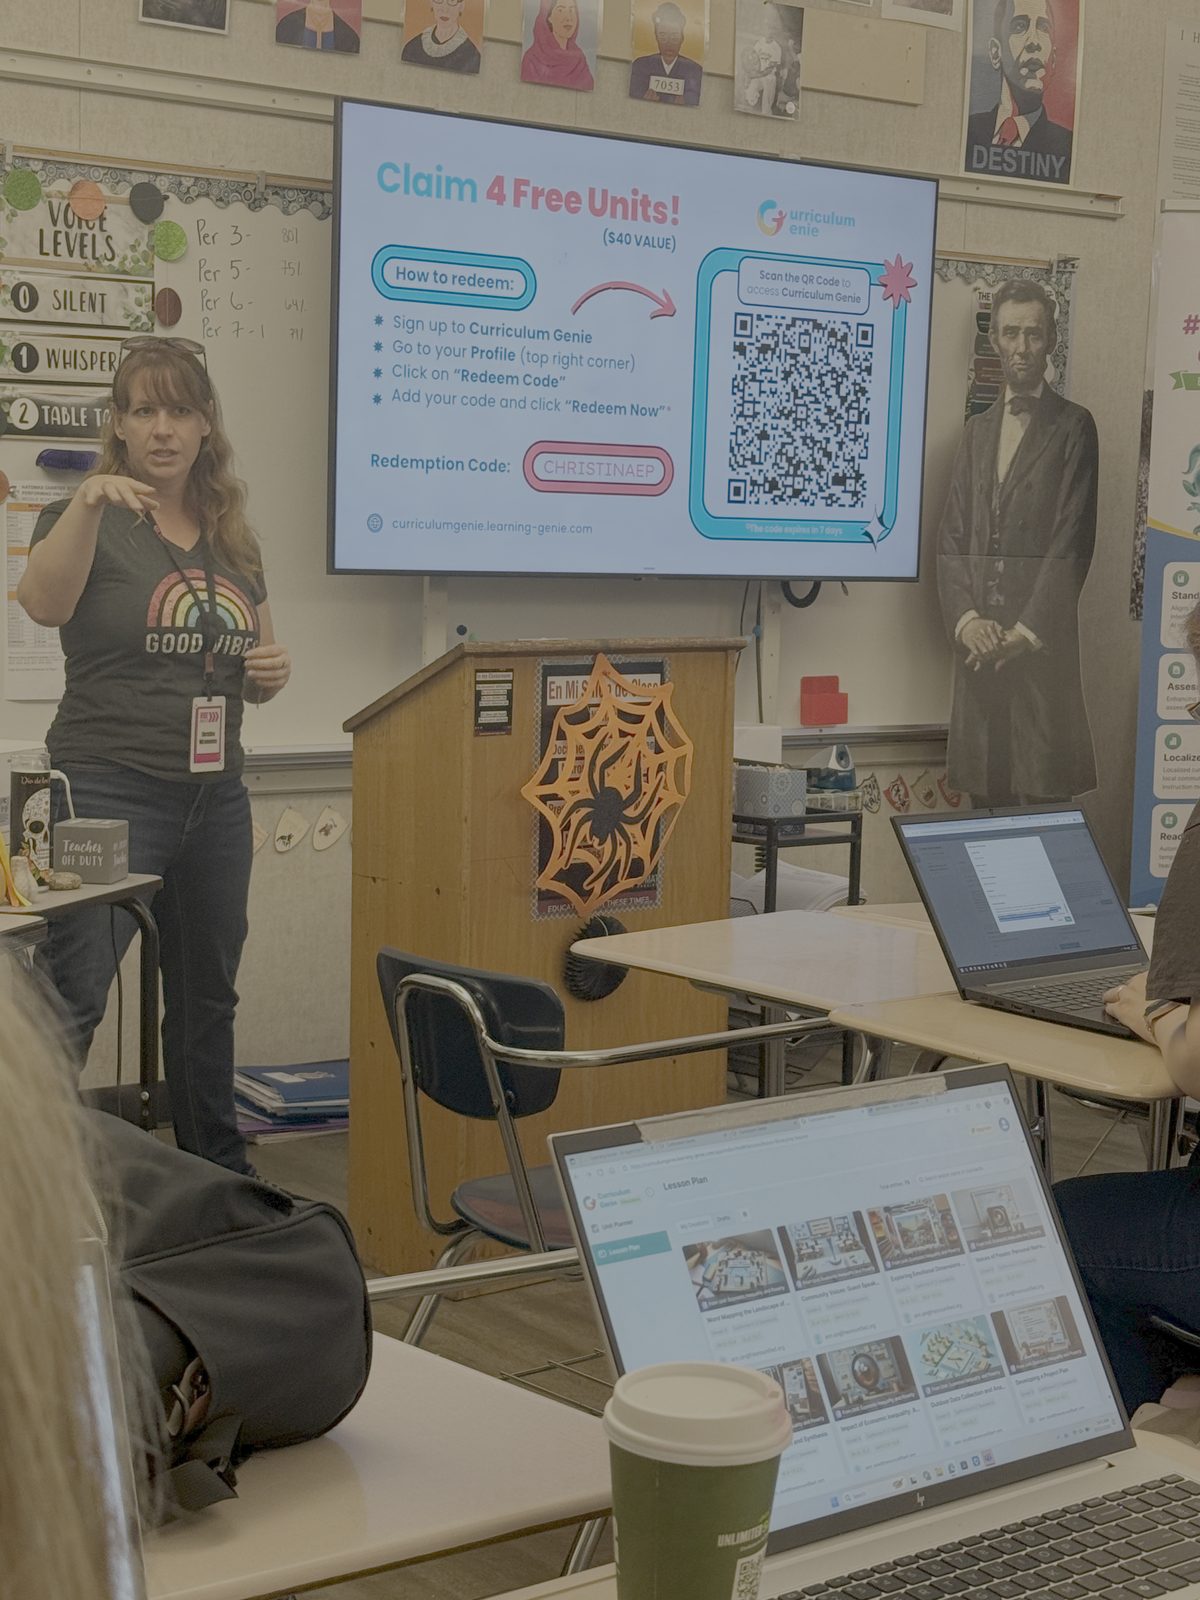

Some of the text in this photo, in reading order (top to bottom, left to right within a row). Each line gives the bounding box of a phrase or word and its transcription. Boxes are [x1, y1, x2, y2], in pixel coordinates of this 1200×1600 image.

[655, 80, 680, 91] 7053
[972, 144, 1066, 178] DESTINY
[377, 161, 680, 226] Claim 4 Free Units!
[197, 218, 218, 246] Per
[603, 227, 677, 254] ($40 VALUE)
[38, 228, 116, 262] LEVELS
[199, 258, 221, 282] Per
[395, 265, 515, 291] How to redeem:
[759, 269, 851, 288] Scan the QR Code to
[19, 285, 30, 309] 0
[52, 289, 107, 313] SILENT
[201, 288, 221, 311] Per
[747, 286, 862, 304] access Curriculum Genie
[202, 316, 222, 339] Per
[393, 315, 593, 344] Sign up to Curriculum Genie
[20, 346, 28, 368] 1
[46, 348, 118, 373] WHISPER
[392, 339, 636, 373] Go to your Profile (top right corner)
[392, 364, 566, 389] Click on "Redeem Code"
[19, 402, 29, 424] 2
[391, 388, 421, 404] Add
[425, 392, 458, 409] your
[460, 394, 496, 408] code
[500, 395, 527, 410] and
[530, 397, 561, 412] click
[565, 399, 627, 416] "Redeem
[41, 406, 88, 427] TABLE
[370, 453, 511, 475] Redemption Code:
[543, 460, 655, 478] CHRISTINAEP
[391, 518, 593, 535] curriculumgenie.learning-genie.com
[765, 523, 783, 534] code
[825, 525, 843, 536] days
[145, 632, 204, 654] GOOD
[548, 681, 562, 699] En
[565, 680, 579, 699] Mi
[63, 840, 104, 854] Teacher
[62, 855, 104, 867] OFF DUTY
[663, 1176, 708, 1191] Lesson Plan
